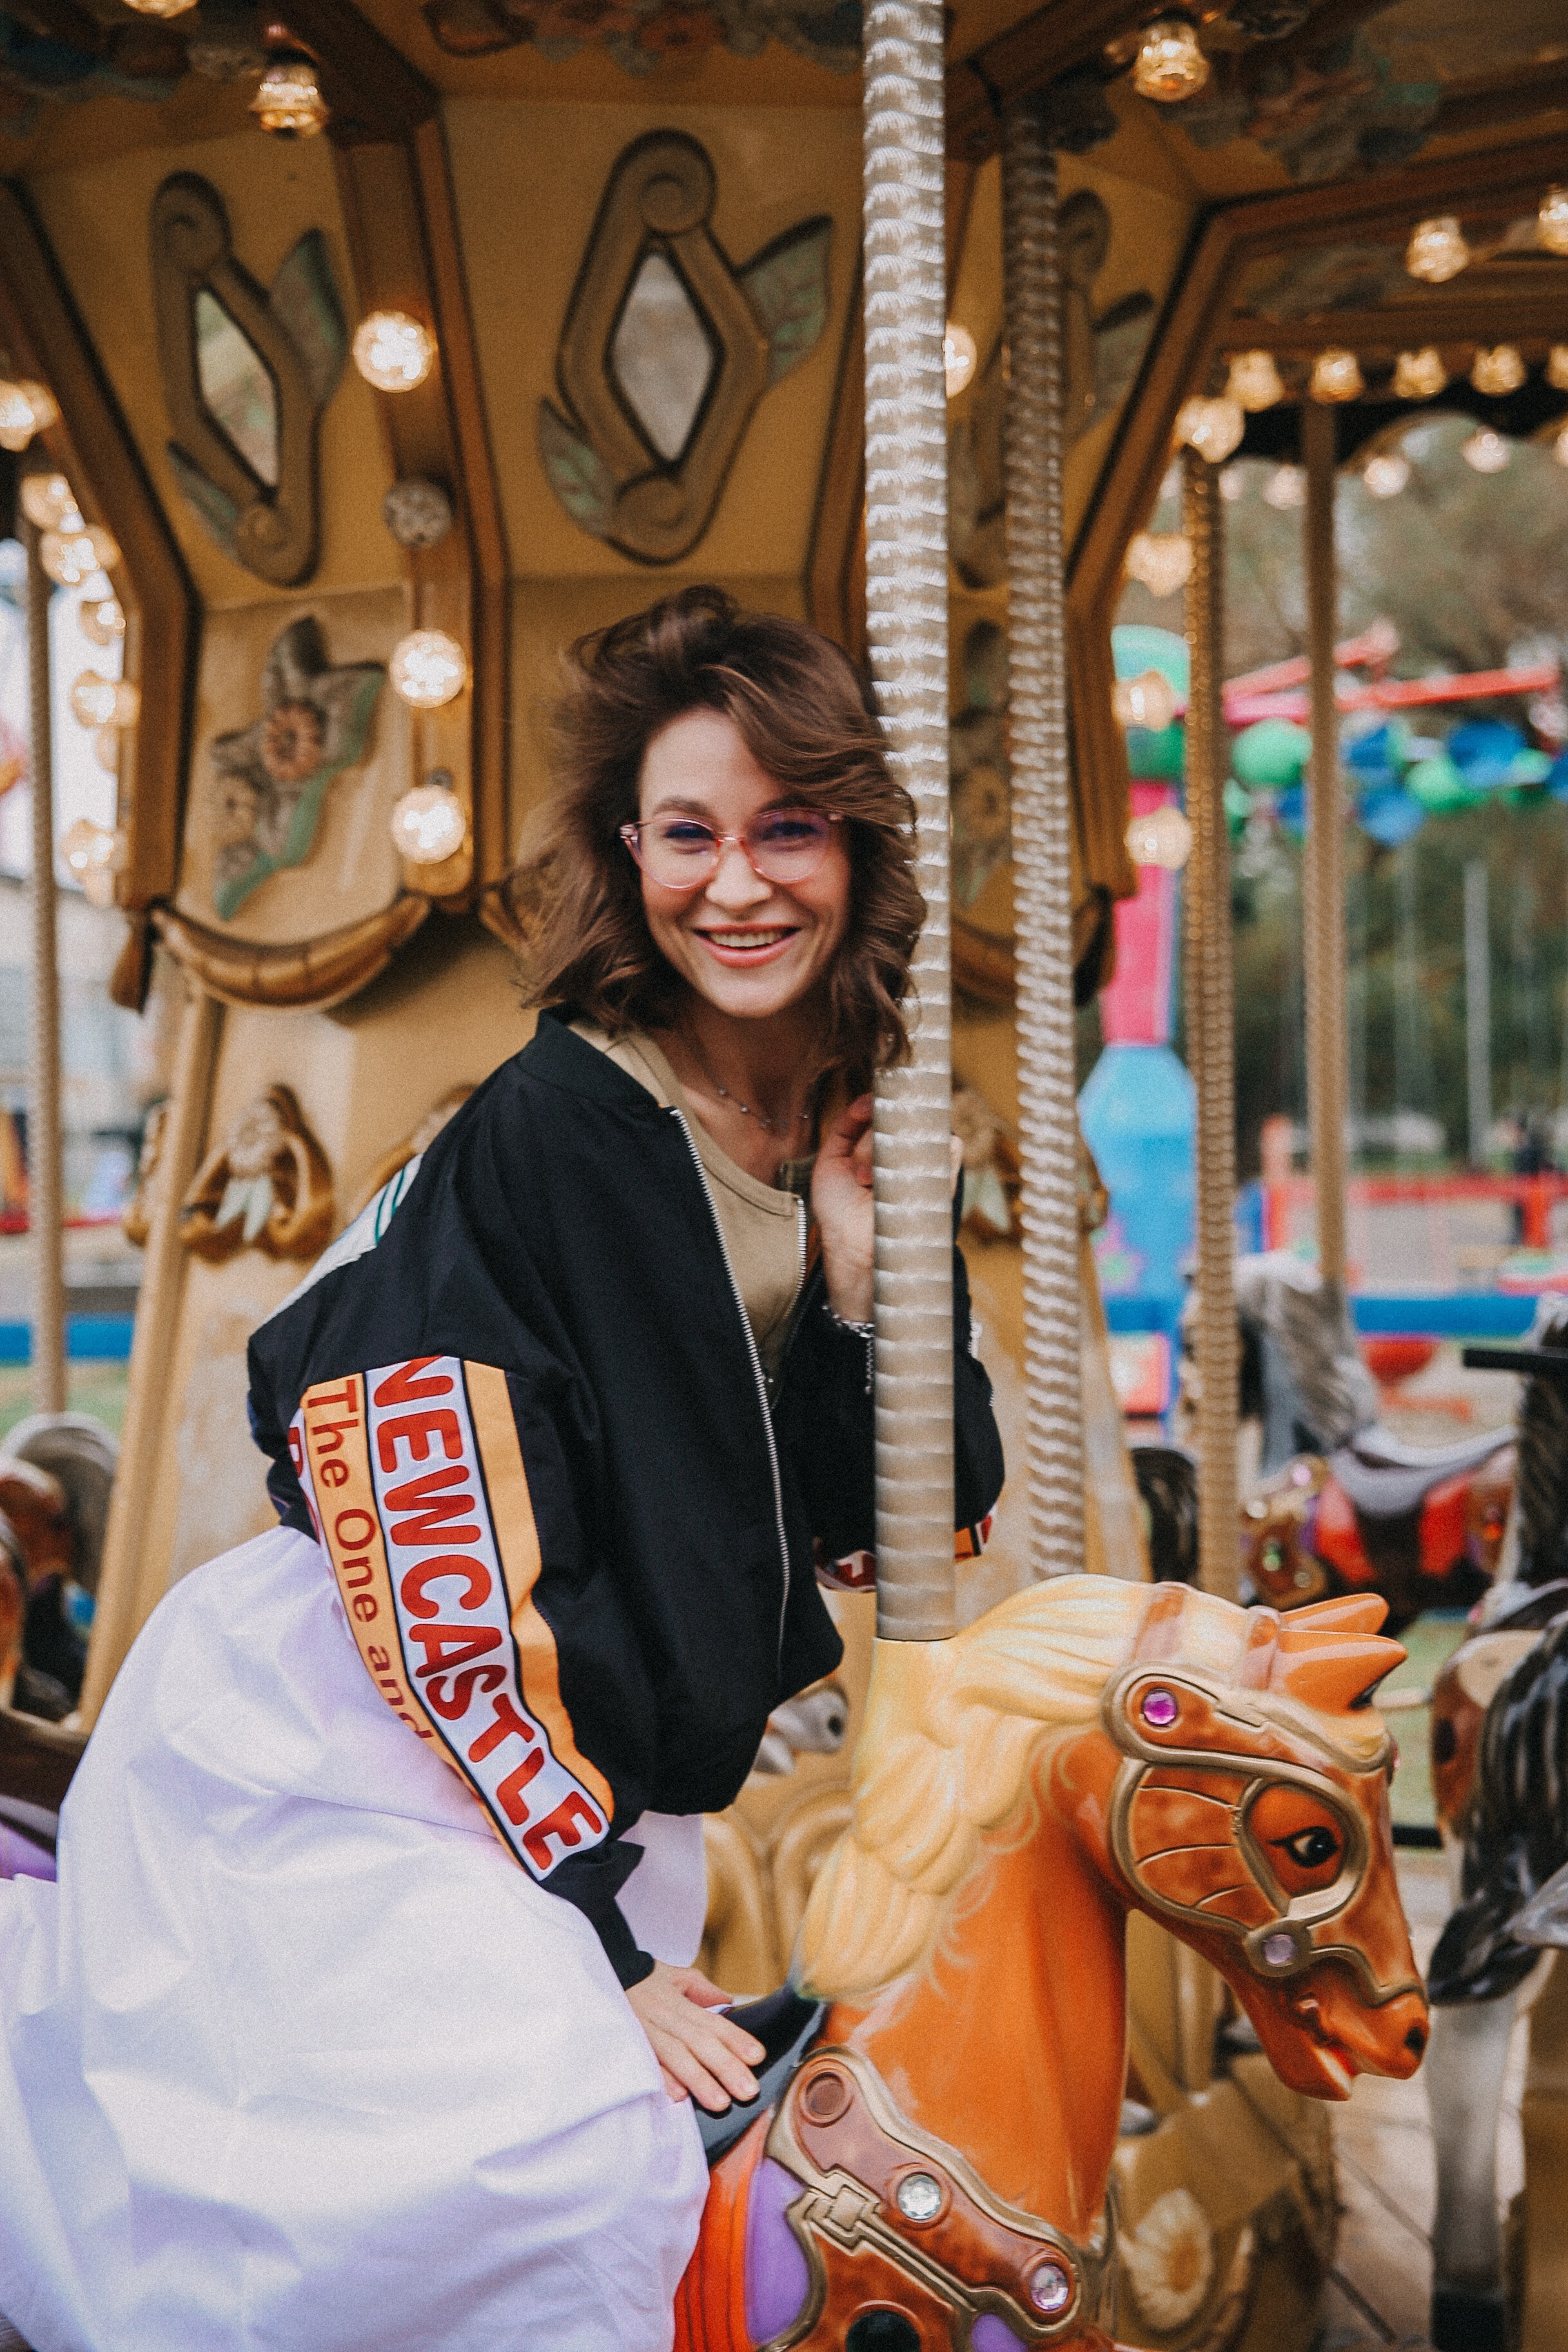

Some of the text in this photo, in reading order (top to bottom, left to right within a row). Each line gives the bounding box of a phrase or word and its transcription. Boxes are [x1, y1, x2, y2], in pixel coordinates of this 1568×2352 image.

[308, 1379, 358, 1488] The
[335, 1509, 378, 1623] One
[374, 1356, 602, 1870] NEWCASTLE
